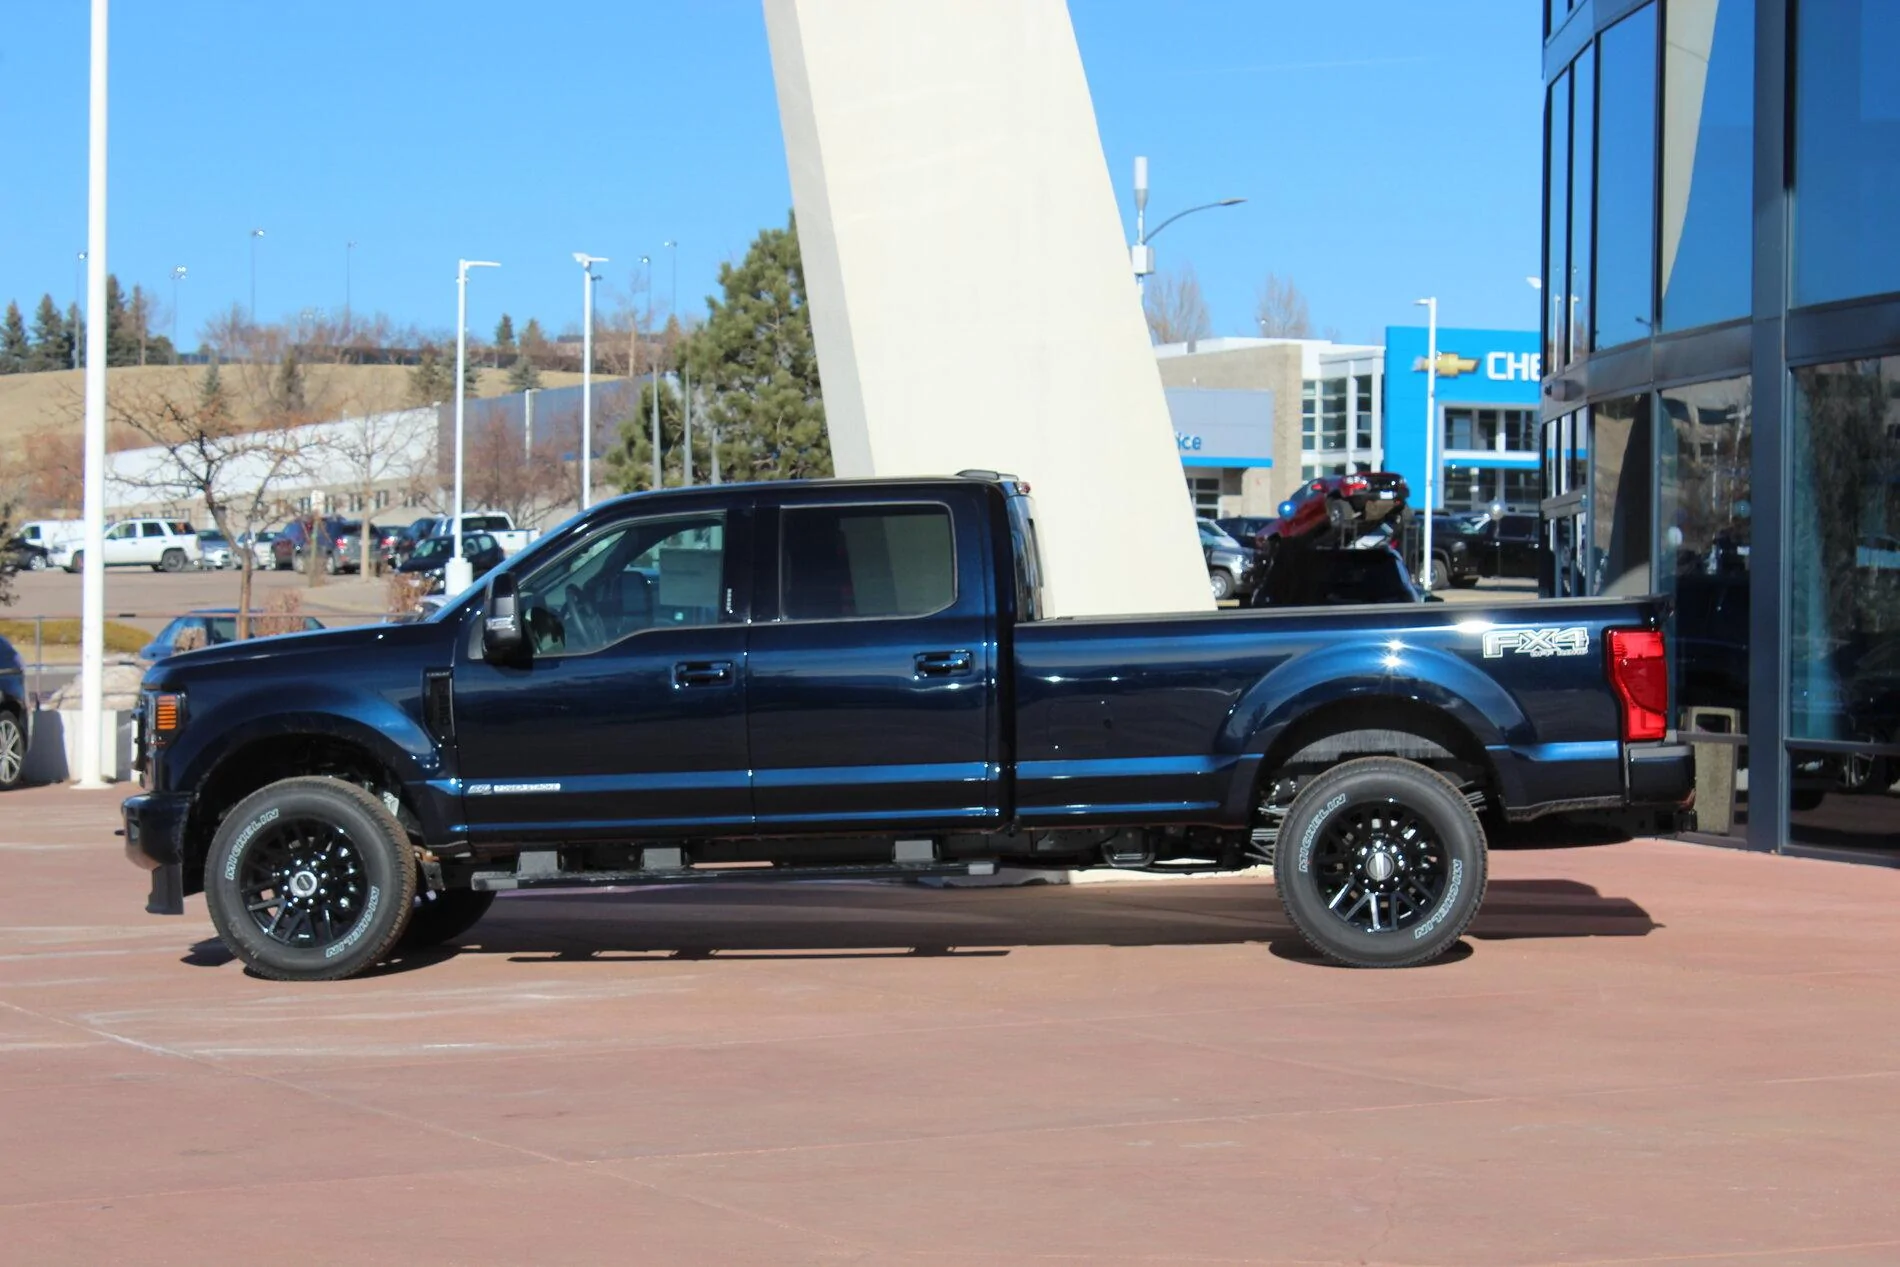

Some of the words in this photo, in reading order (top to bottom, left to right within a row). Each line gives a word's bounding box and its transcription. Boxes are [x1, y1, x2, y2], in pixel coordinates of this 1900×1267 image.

[1483, 627, 1589, 658] FX4
[225, 808, 279, 880] MICHELIN
[1299, 793, 1346, 873] MICHELIN
[326, 886, 379, 958] MICHELIN
[1415, 859, 1463, 939] MICHELIN
